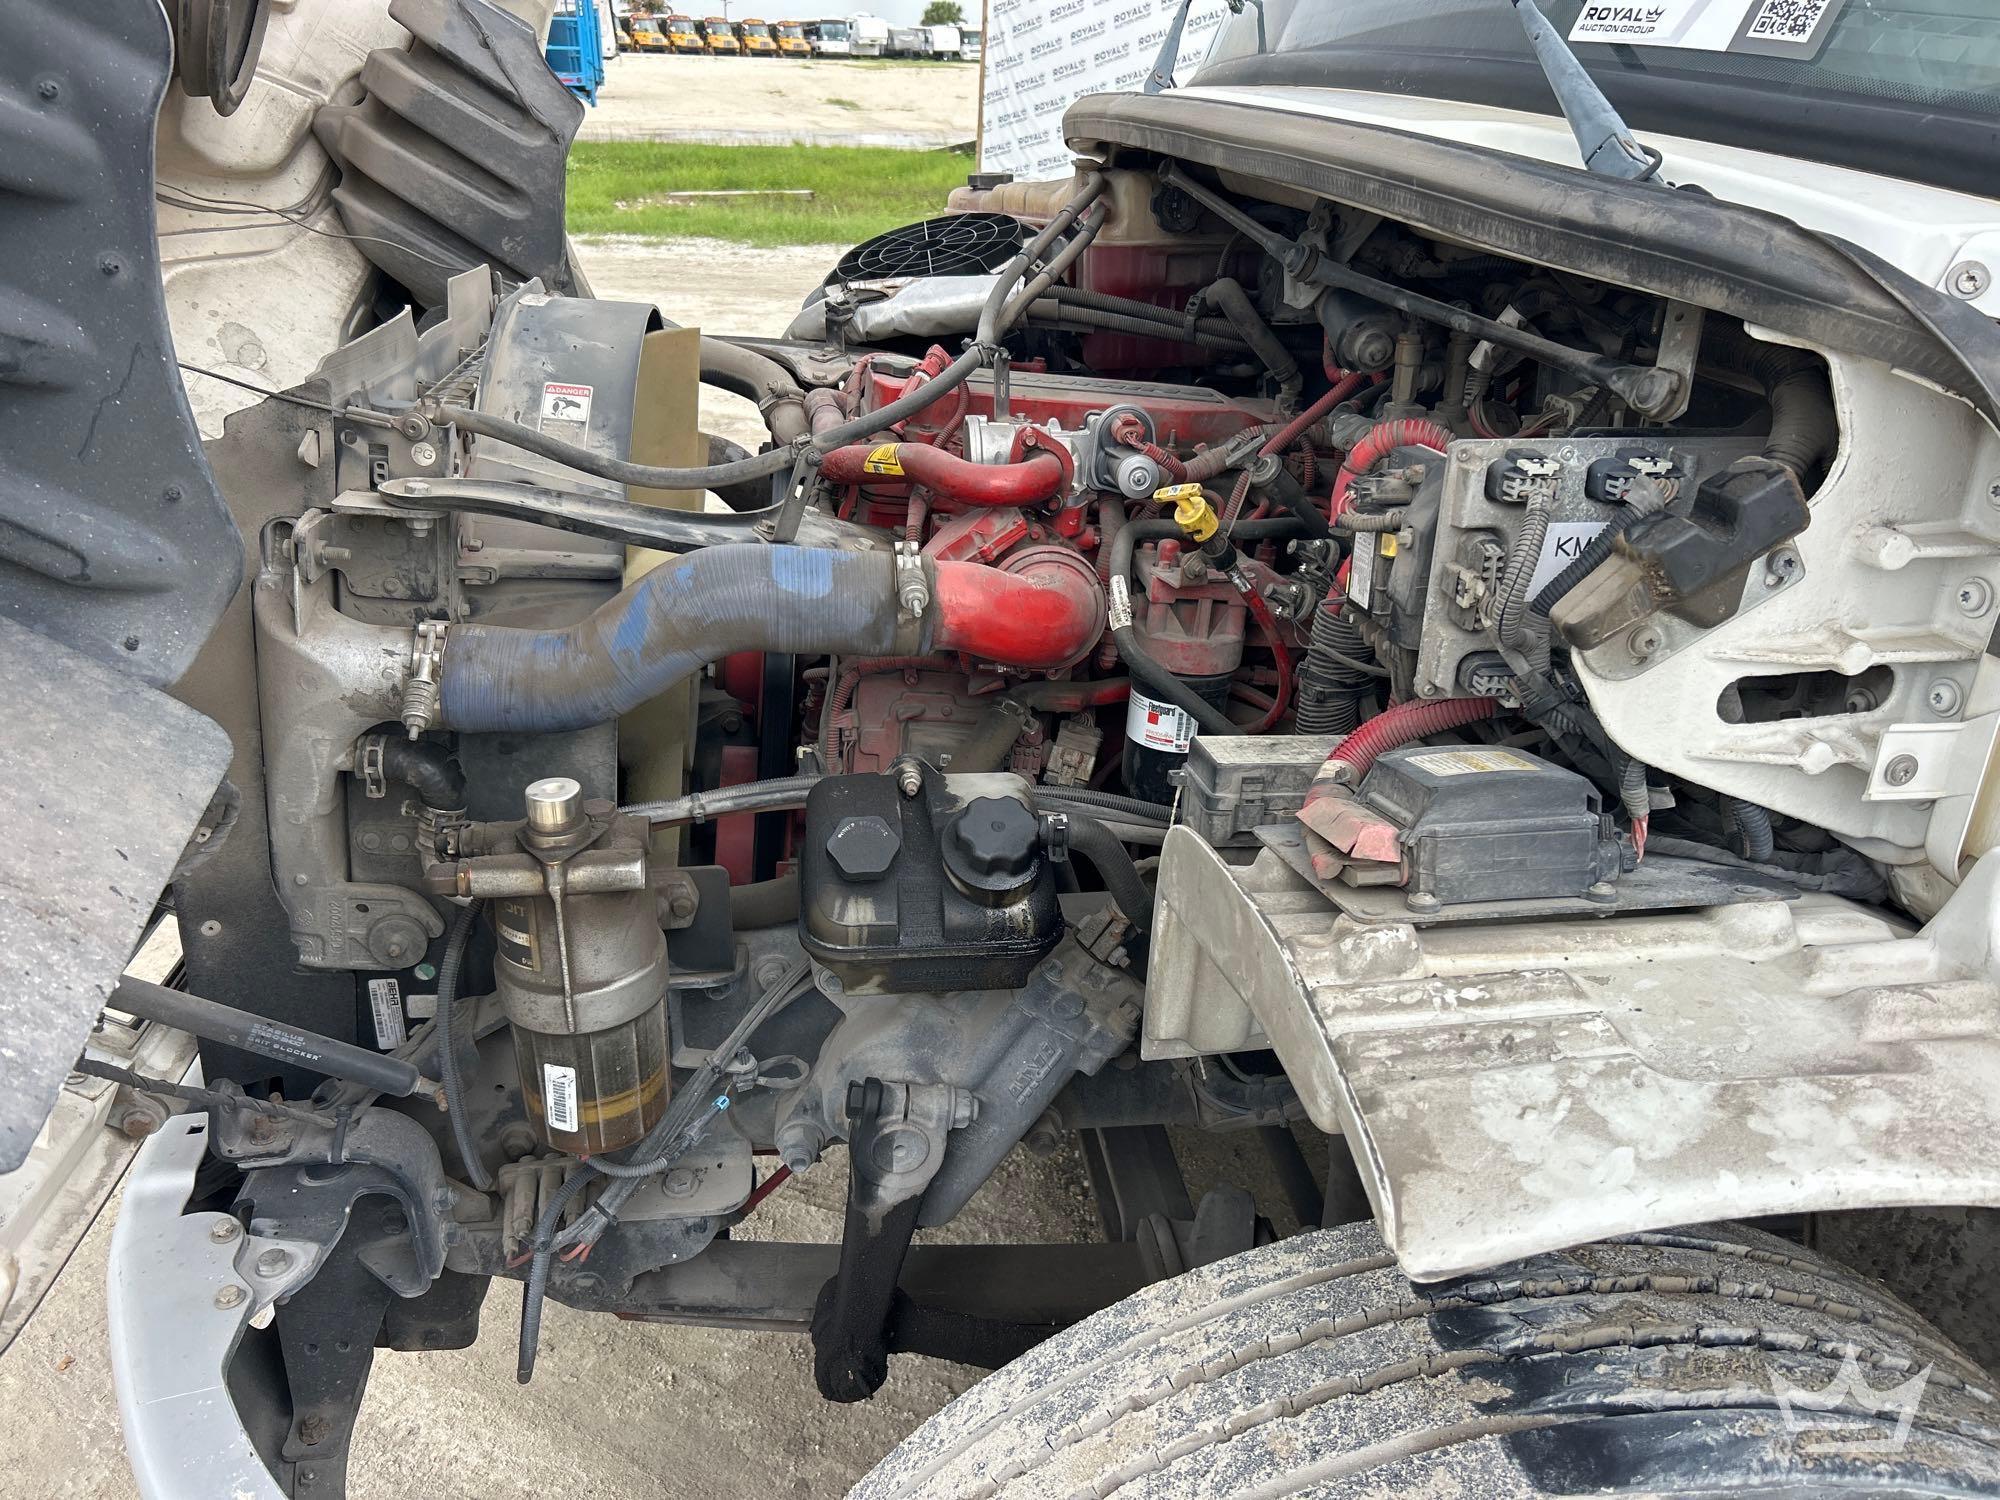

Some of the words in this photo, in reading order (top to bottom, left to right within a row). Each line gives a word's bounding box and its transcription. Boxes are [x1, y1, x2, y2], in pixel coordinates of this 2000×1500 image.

[1050, 1, 1077, 17] ROYAL
[1113, 6, 1142, 23] ROYAL
[1584, 7, 1644, 22] ROYAL
[1012, 19, 1035, 33] ROYAL
[1187, 10, 1221, 29] ROYAL
[1071, 25, 1097, 39] ROYAL
[1578, 23, 1619, 33] AUCTION
[1619, 25, 1655, 35] GROUP
[1031, 40, 1056, 54] ROYAL
[1094, 46, 1121, 62] ROYAL
[995, 55, 1017, 68] ROYAL
[1053, 62, 1077, 76] ROYAL
[1015, 76, 1039, 89] ROYAL
[1115, 70, 1144, 84] ROYAL
[1034, 99, 1058, 111] ROYAL
[998, 111, 1020, 122] ROYAL
[1018, 133, 1042, 144] ROYAL
[984, 144, 1006, 154] ROYAL
[1037, 156, 1060, 167] ROYAL
[556, 388, 590, 397] DANGER
[1149, 701, 1176, 717] Fleetguard
[252, 1023, 305, 1042] STABILUS
